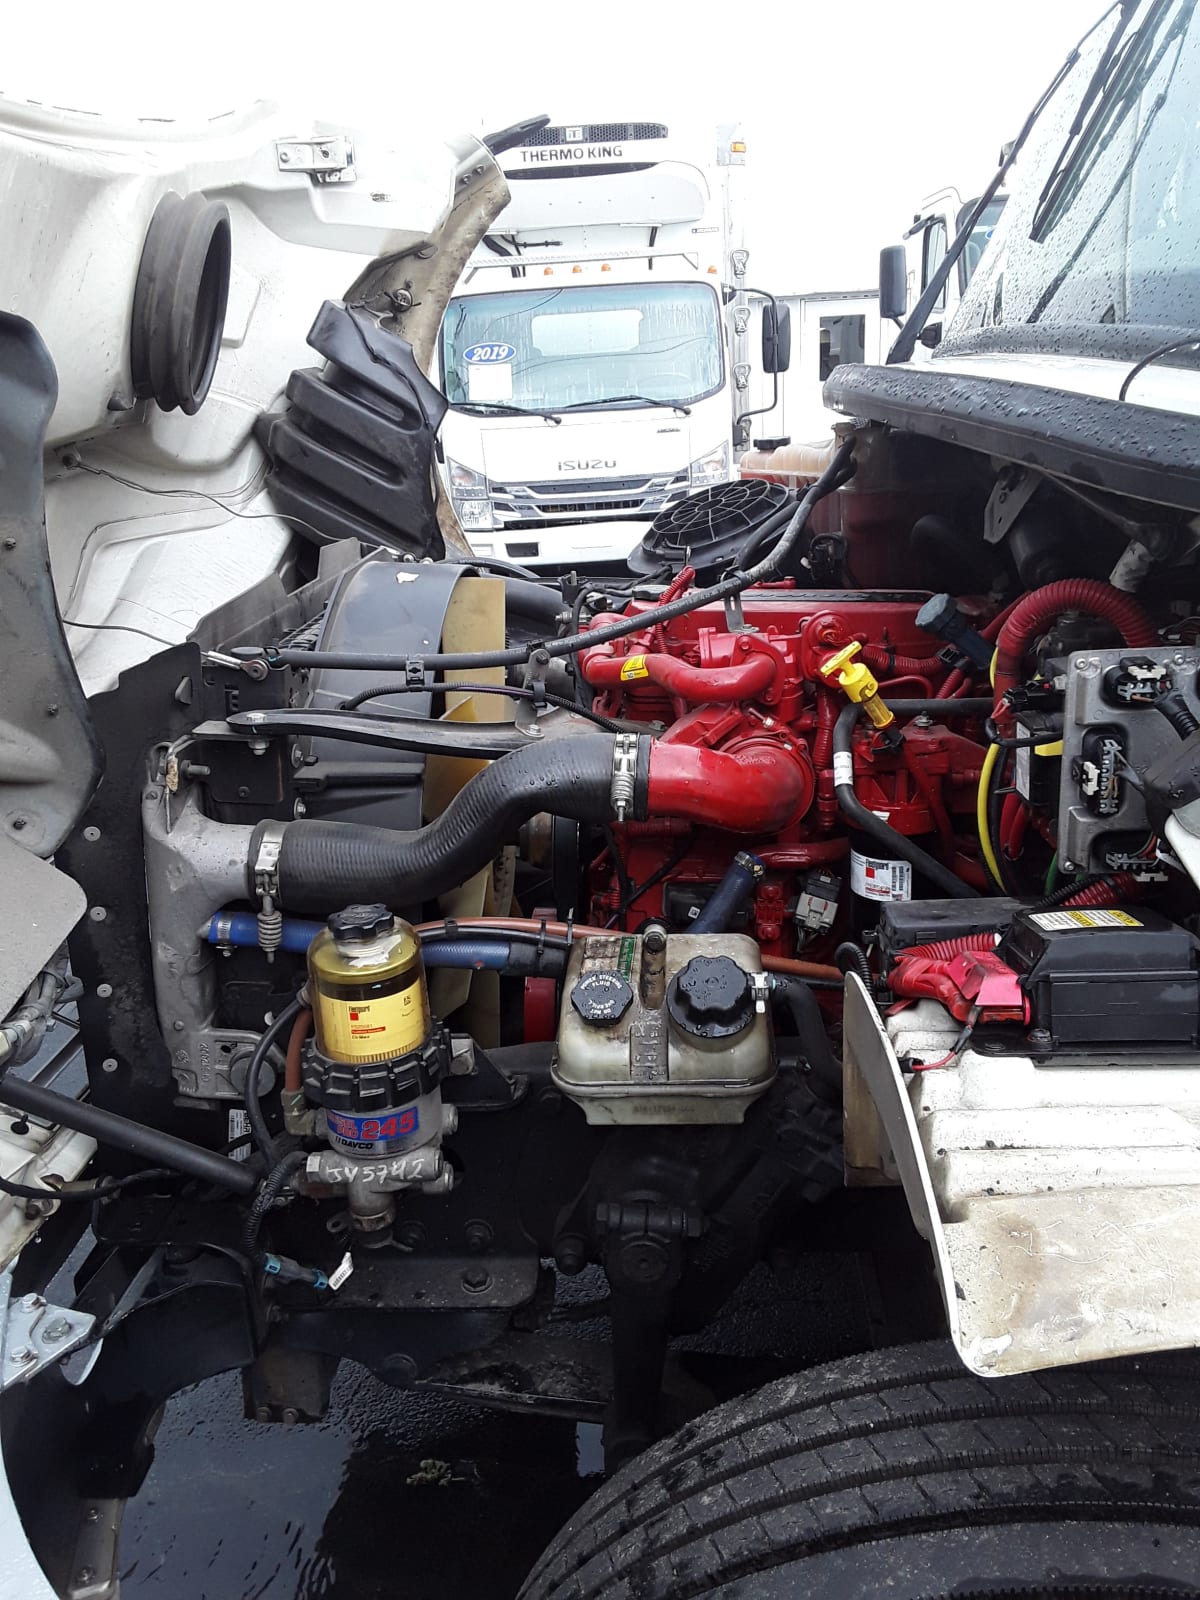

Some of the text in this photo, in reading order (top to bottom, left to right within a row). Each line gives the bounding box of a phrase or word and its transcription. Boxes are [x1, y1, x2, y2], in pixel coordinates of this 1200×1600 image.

[520, 145, 623, 162] THERMO KING
[471, 346, 509, 361] 2019
[558, 460, 616, 471] ISUZU
[361, 1110, 415, 1140] 245
[341, 1139, 374, 1150] DAYCO
